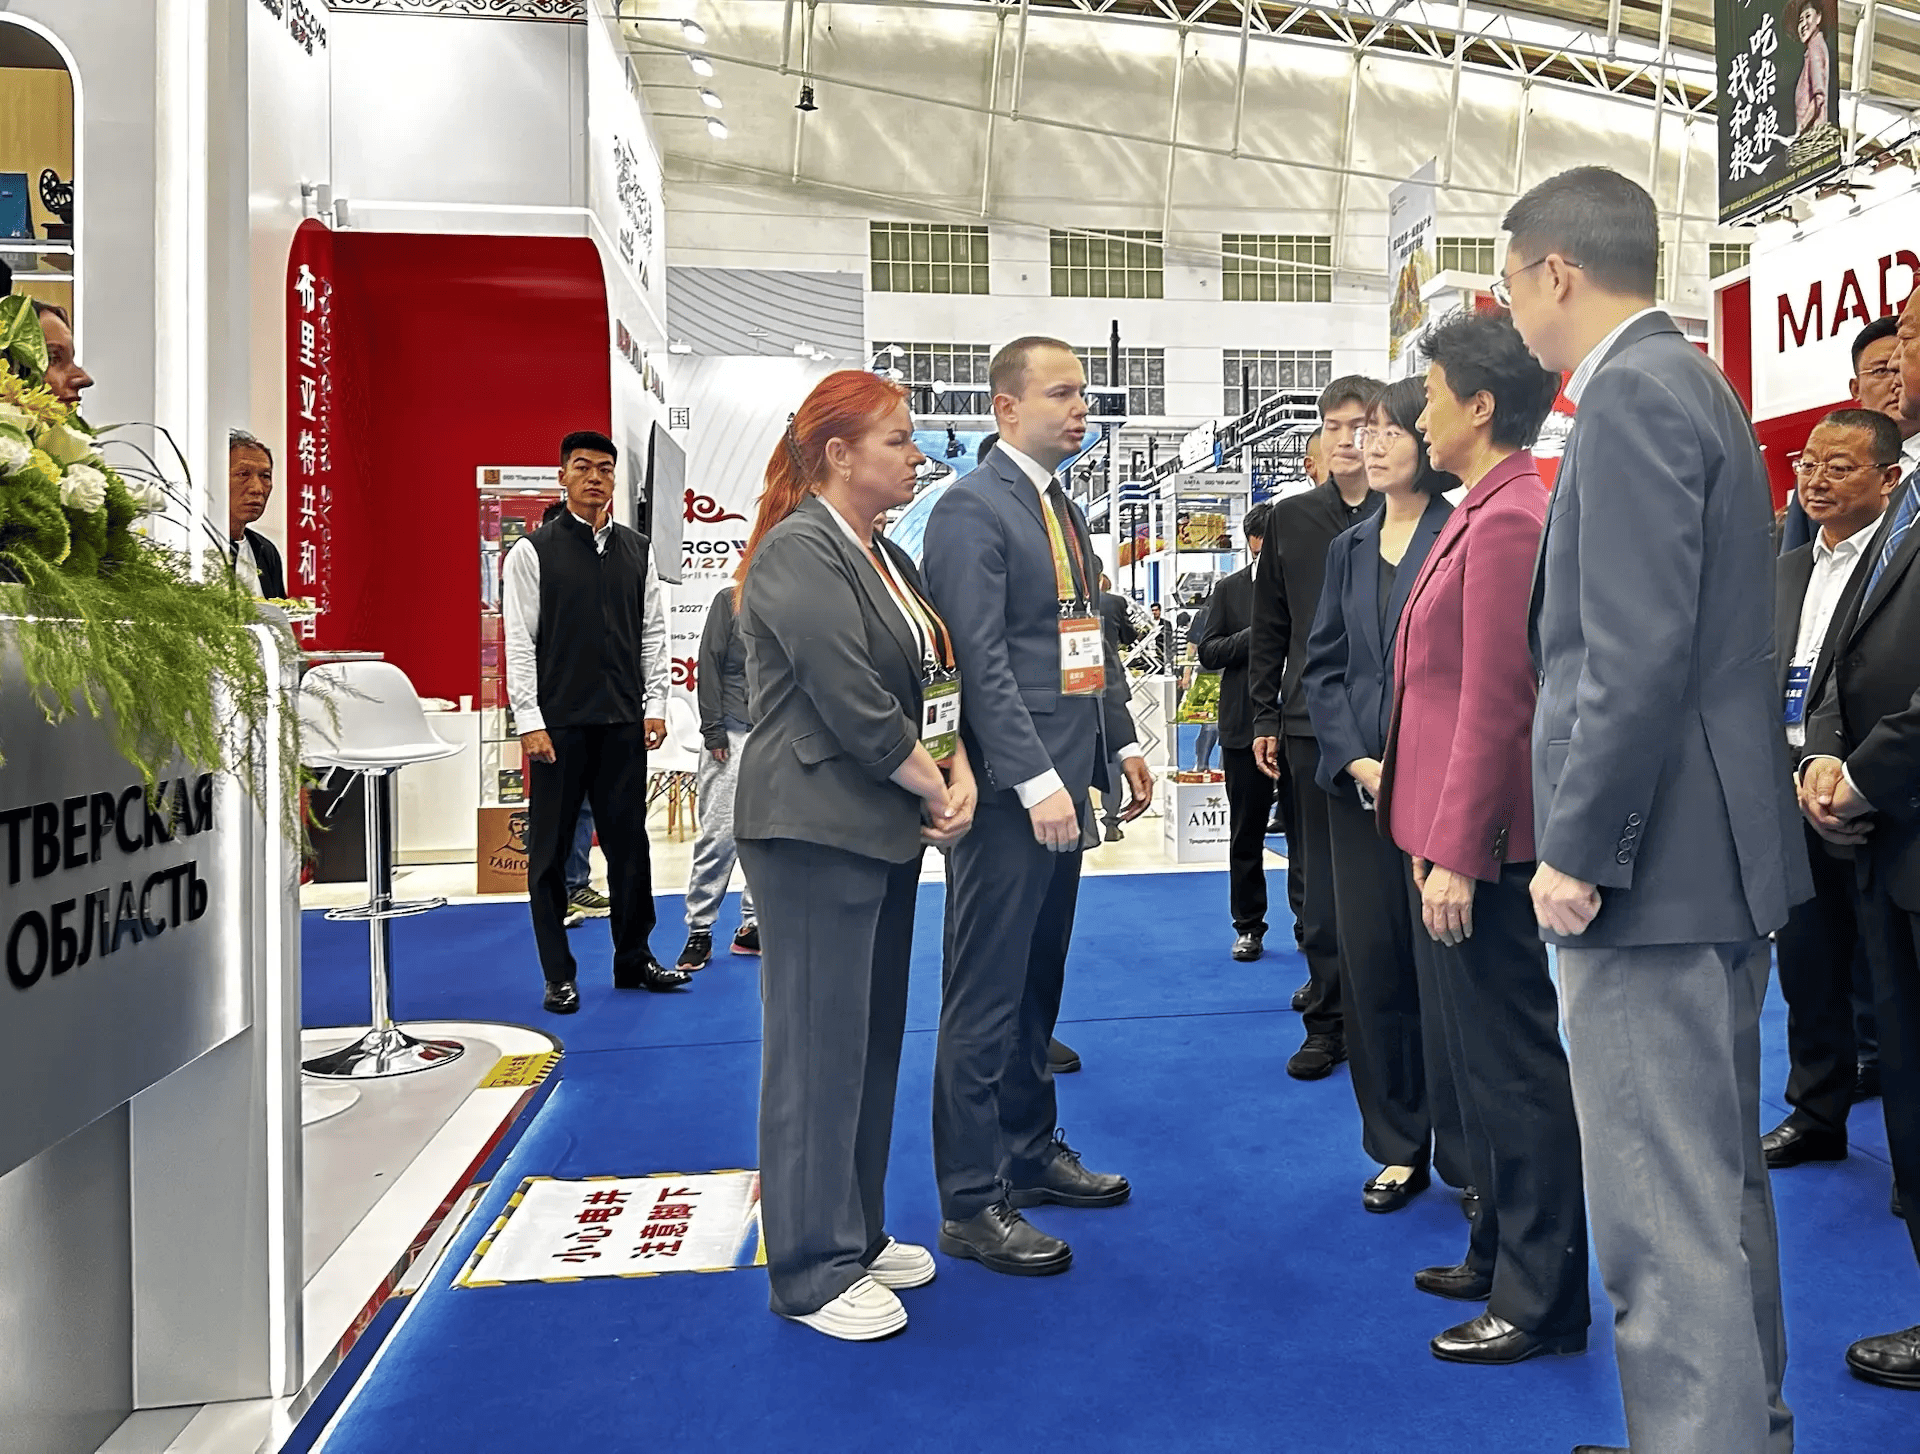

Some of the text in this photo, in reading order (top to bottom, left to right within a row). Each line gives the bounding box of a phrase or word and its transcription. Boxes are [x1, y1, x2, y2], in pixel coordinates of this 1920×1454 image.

[1727, 52, 1777, 181] 找和粮
[1749, 13, 1795, 156] 吃杂粮
[669, 407, 690, 430] 国
[679, 605, 703, 613] 2027
[0, 772, 214, 886] ТВЕРСКАЯ
[6, 860, 209, 991] ОБЛАСТЬ
[552, 1189, 633, 1263] 小心电井
